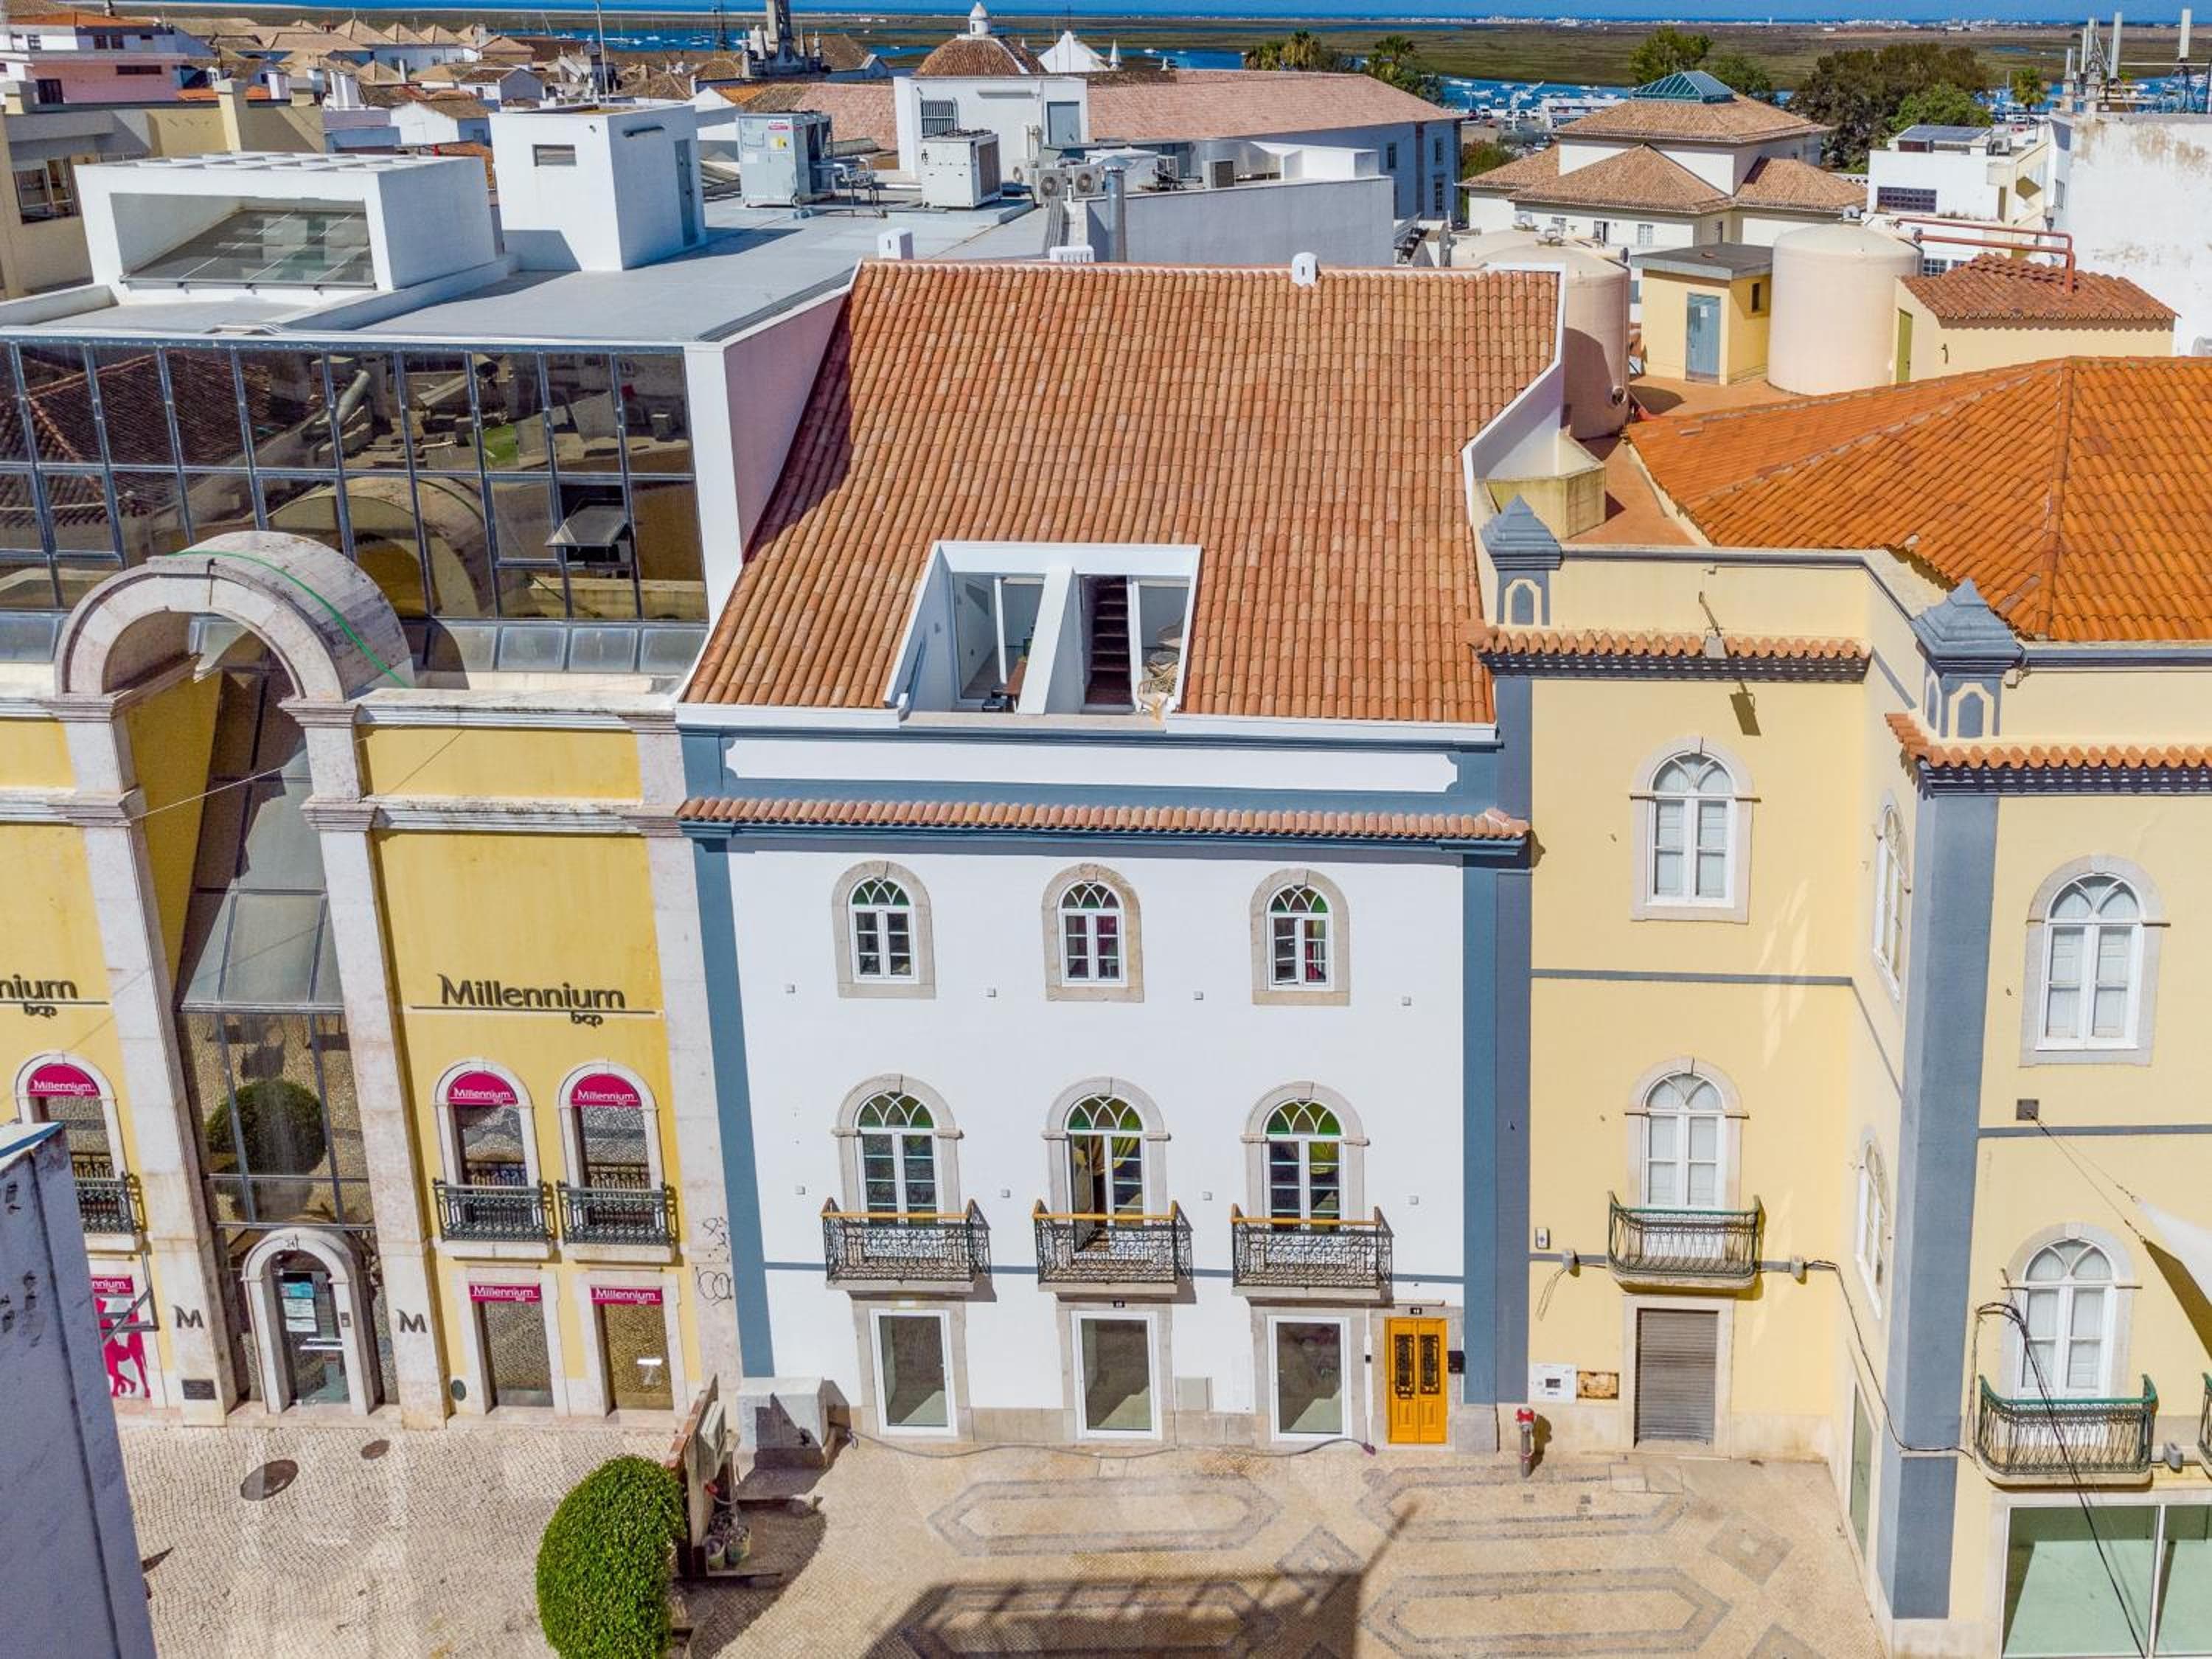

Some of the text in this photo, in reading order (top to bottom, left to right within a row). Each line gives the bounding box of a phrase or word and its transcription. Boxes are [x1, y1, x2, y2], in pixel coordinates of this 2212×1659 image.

[437, 973, 625, 1009] Millennium
[571, 1011, 603, 1028] bcp
[33, 1079, 92, 1090] Millennium
[453, 1087, 511, 1098] Millennium
[577, 1089, 634, 1101] Millennium
[473, 1285, 533, 1297] Millennium
[595, 1287, 655, 1300] Millennium
[173, 1304, 204, 1328] M
[397, 1309, 428, 1333] M
